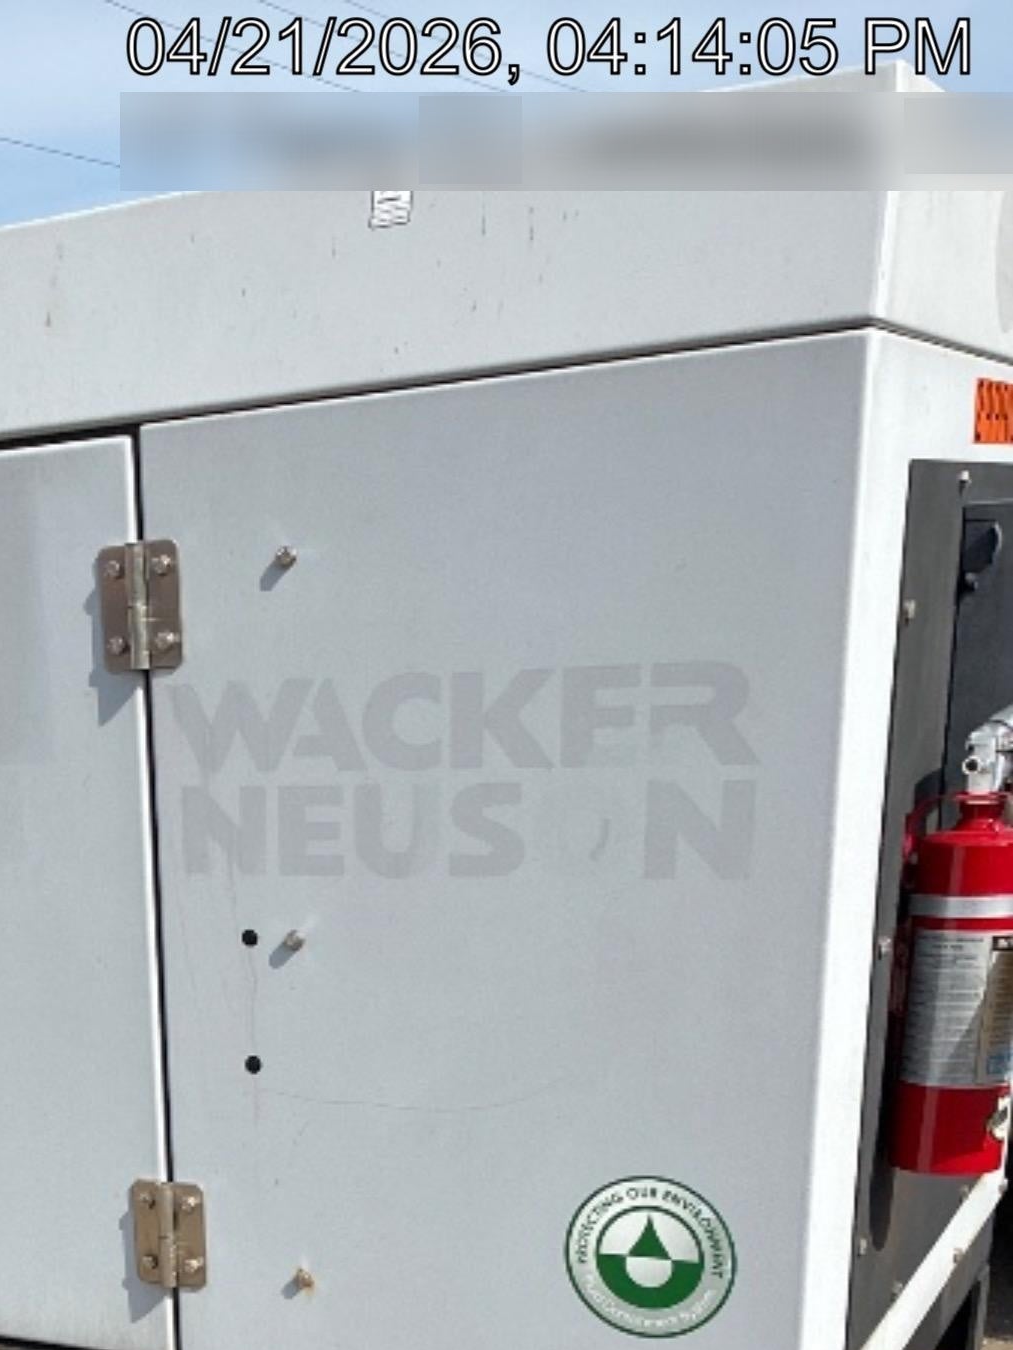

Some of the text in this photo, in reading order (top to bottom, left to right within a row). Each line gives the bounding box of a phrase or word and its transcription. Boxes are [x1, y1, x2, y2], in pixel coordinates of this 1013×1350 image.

[180, 778, 757, 881] NEUSN
[576, 1186, 724, 1279] PROTECTING OUR ENVIRONMENT
